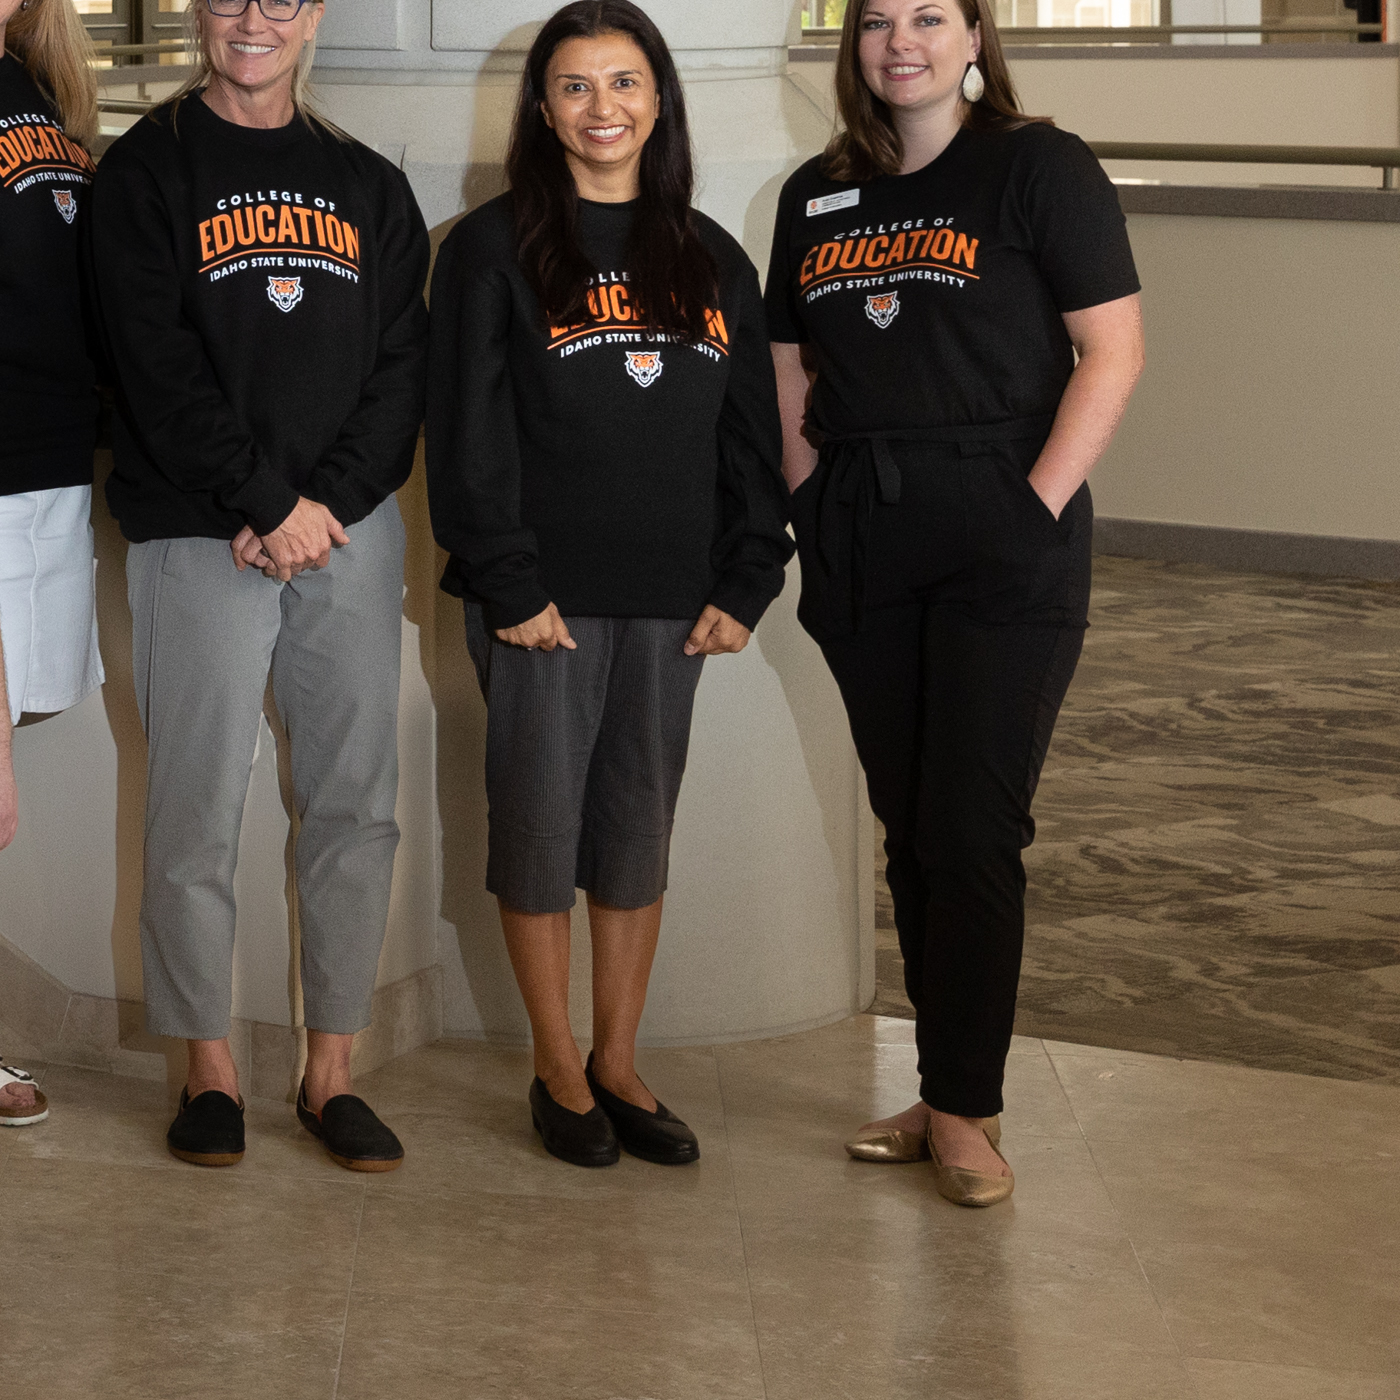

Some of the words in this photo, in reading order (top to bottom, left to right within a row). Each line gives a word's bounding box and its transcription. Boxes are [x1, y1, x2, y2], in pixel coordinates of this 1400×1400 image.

[14, 176, 36, 194] IDAHO
[36, 172, 58, 182] STATE
[217, 190, 303, 210] COLLEGE
[314, 198, 336, 212] OF
[199, 204, 360, 264] EDUCATION
[834, 219, 924, 240] COLLEGE
[933, 217, 954, 227] OF
[800, 228, 979, 286] EDUCATION
[210, 260, 248, 282] IDAHO
[251, 257, 284, 267] STATE
[288, 257, 359, 284] UNIVERSITY
[806, 282, 842, 304] IDAHO
[846, 276, 885, 289] STATE
[889, 270, 965, 288] UNIVERSITY
[561, 333, 602, 358] IDAHO
[605, 333, 642, 343] STATE
